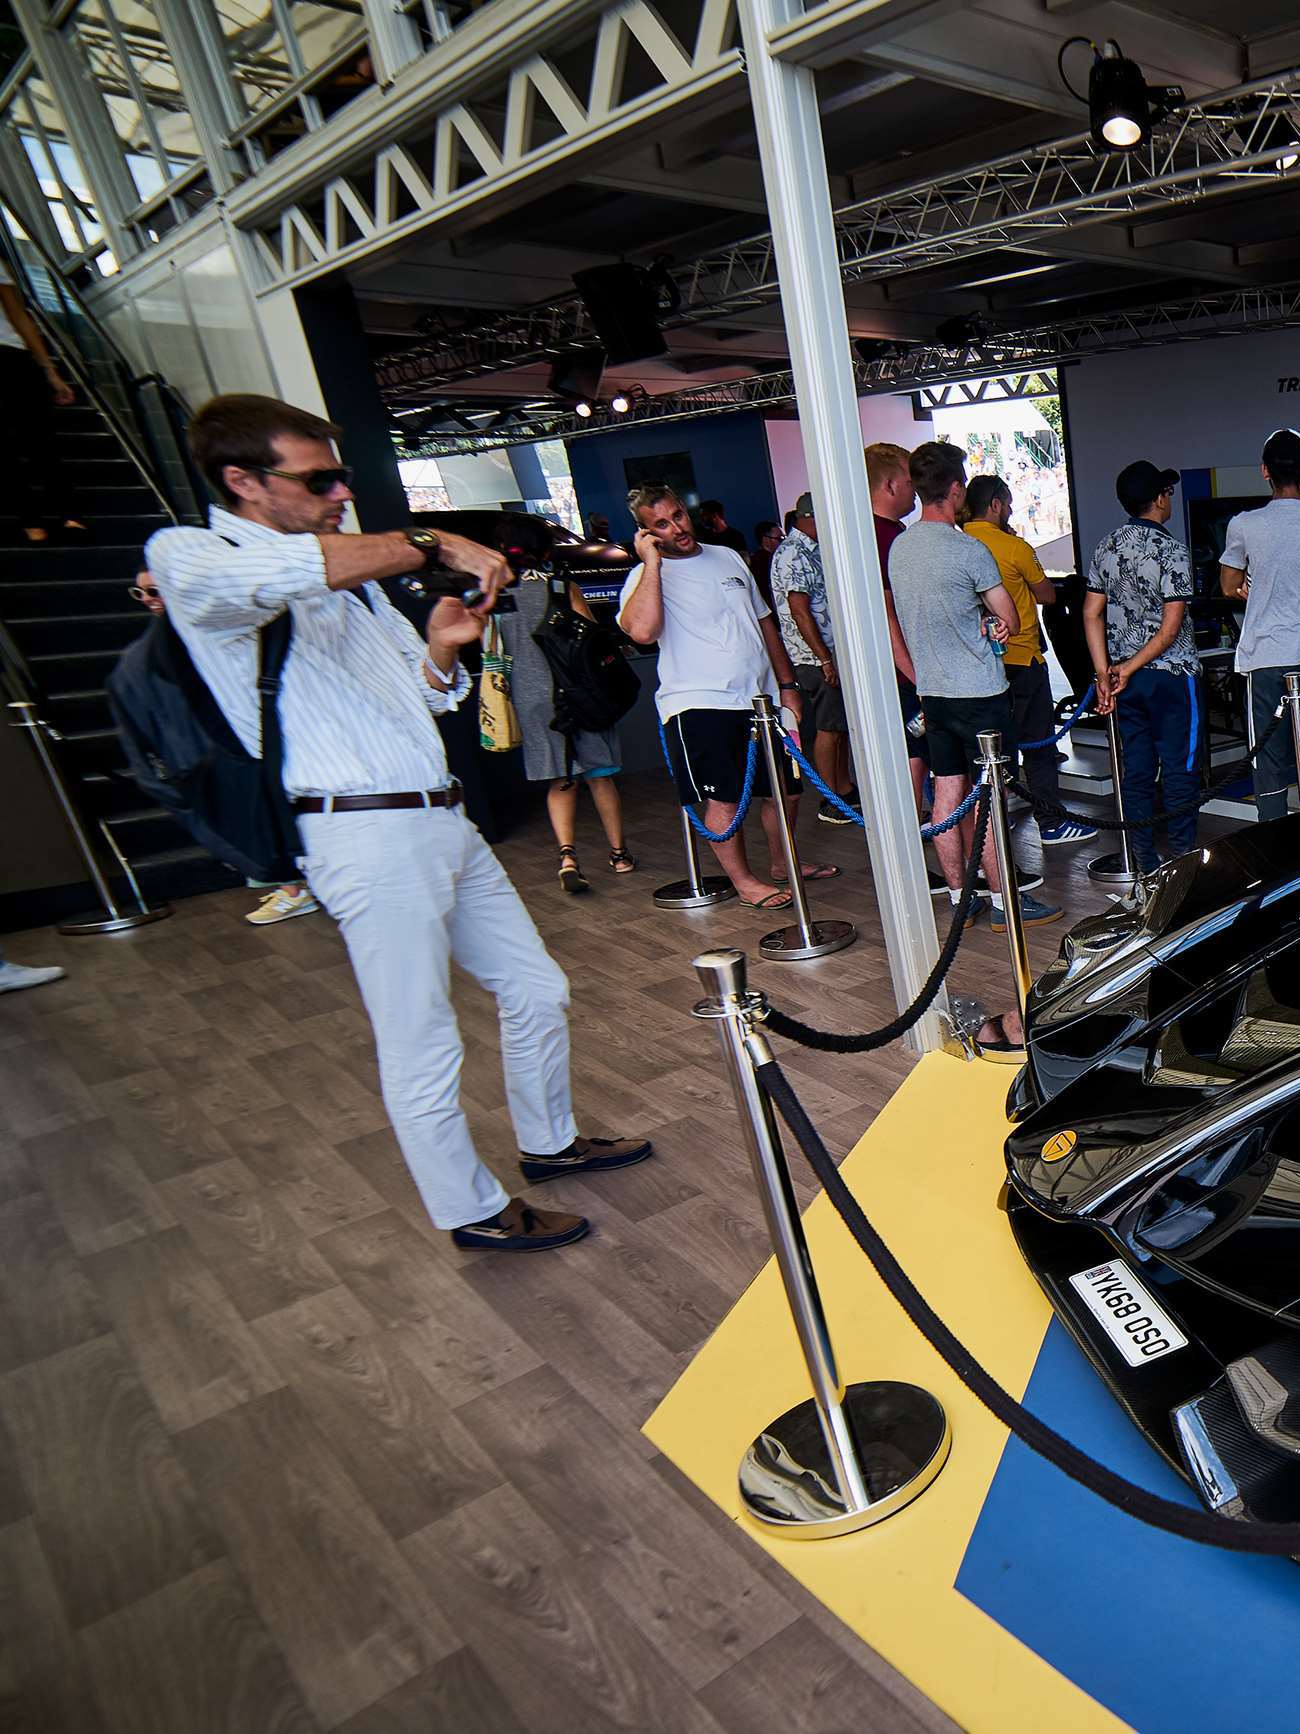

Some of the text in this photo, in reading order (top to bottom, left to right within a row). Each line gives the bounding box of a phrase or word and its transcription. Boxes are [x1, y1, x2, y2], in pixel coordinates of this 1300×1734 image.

[583, 590, 618, 599] CHELIN
[1091, 1271, 1170, 1356] YK68 OSO
